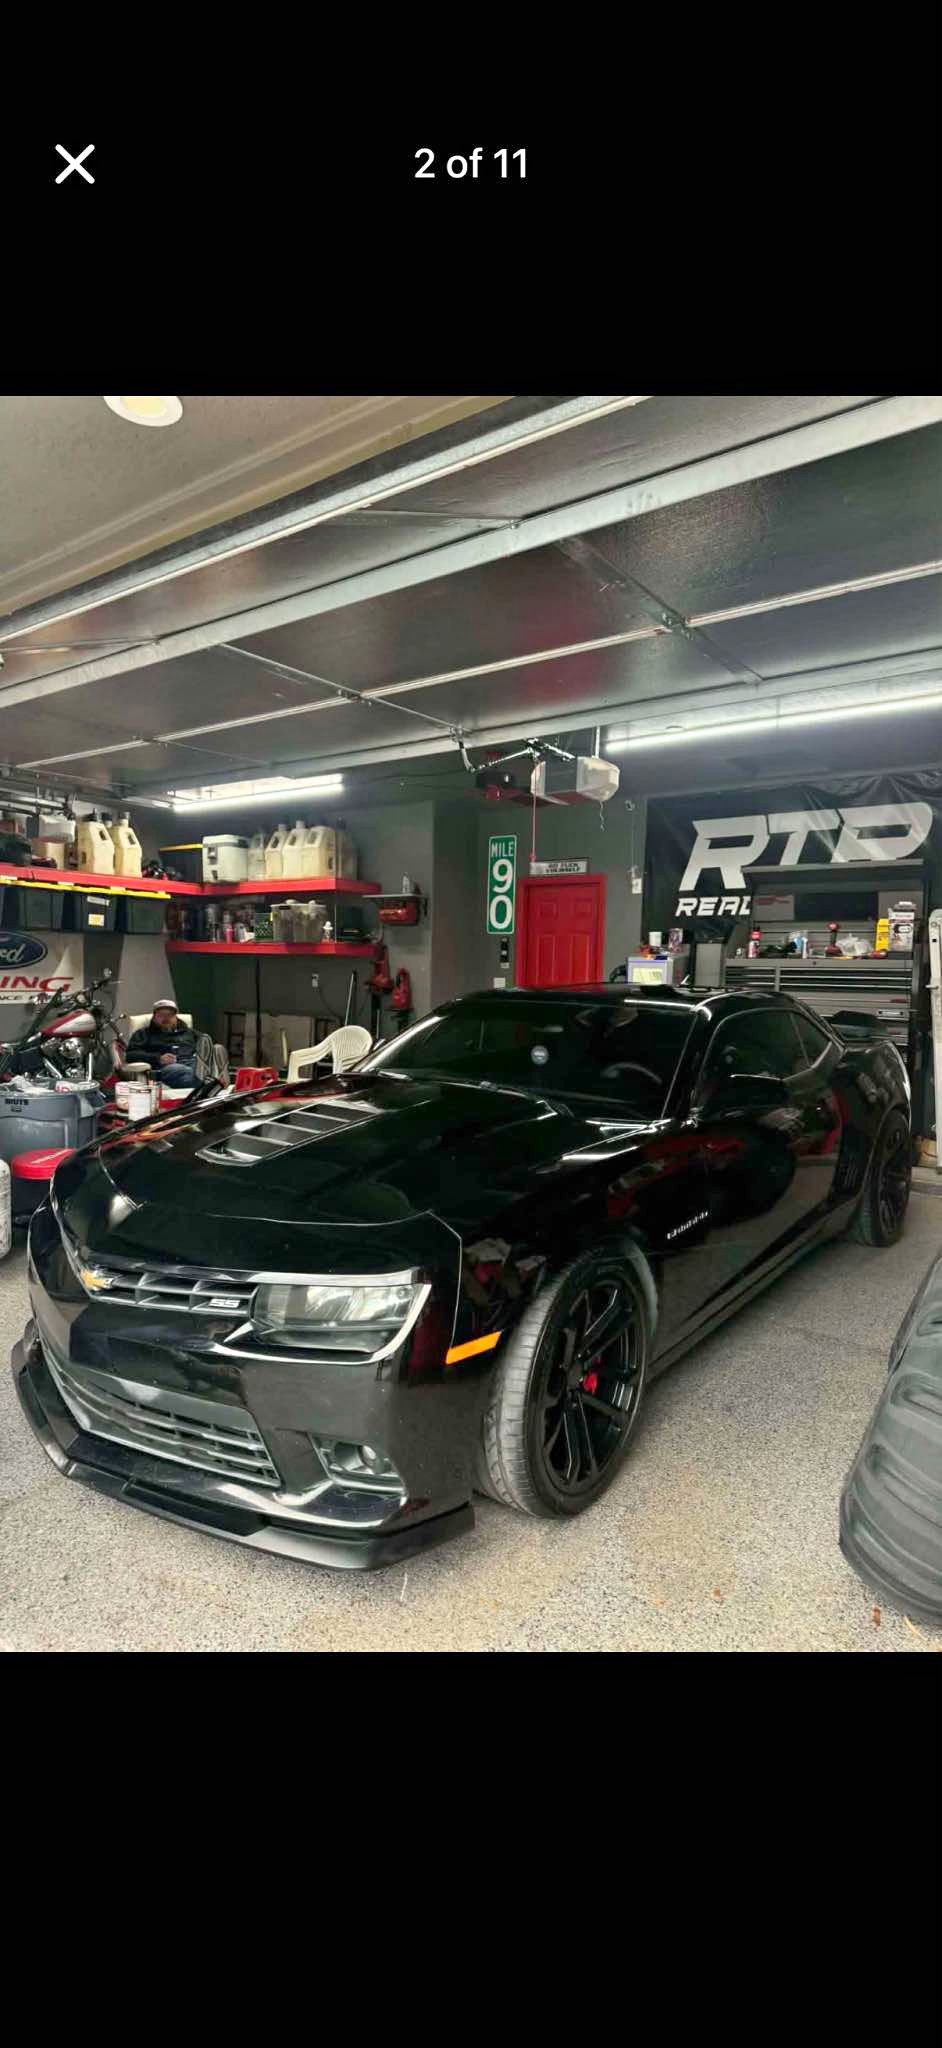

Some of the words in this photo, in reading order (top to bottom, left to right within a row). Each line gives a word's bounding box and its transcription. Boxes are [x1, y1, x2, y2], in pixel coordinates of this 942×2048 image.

[491, 841, 515, 857] MILE
[489, 858, 514, 930] 90
[209, 1298, 240, 1308] SS
